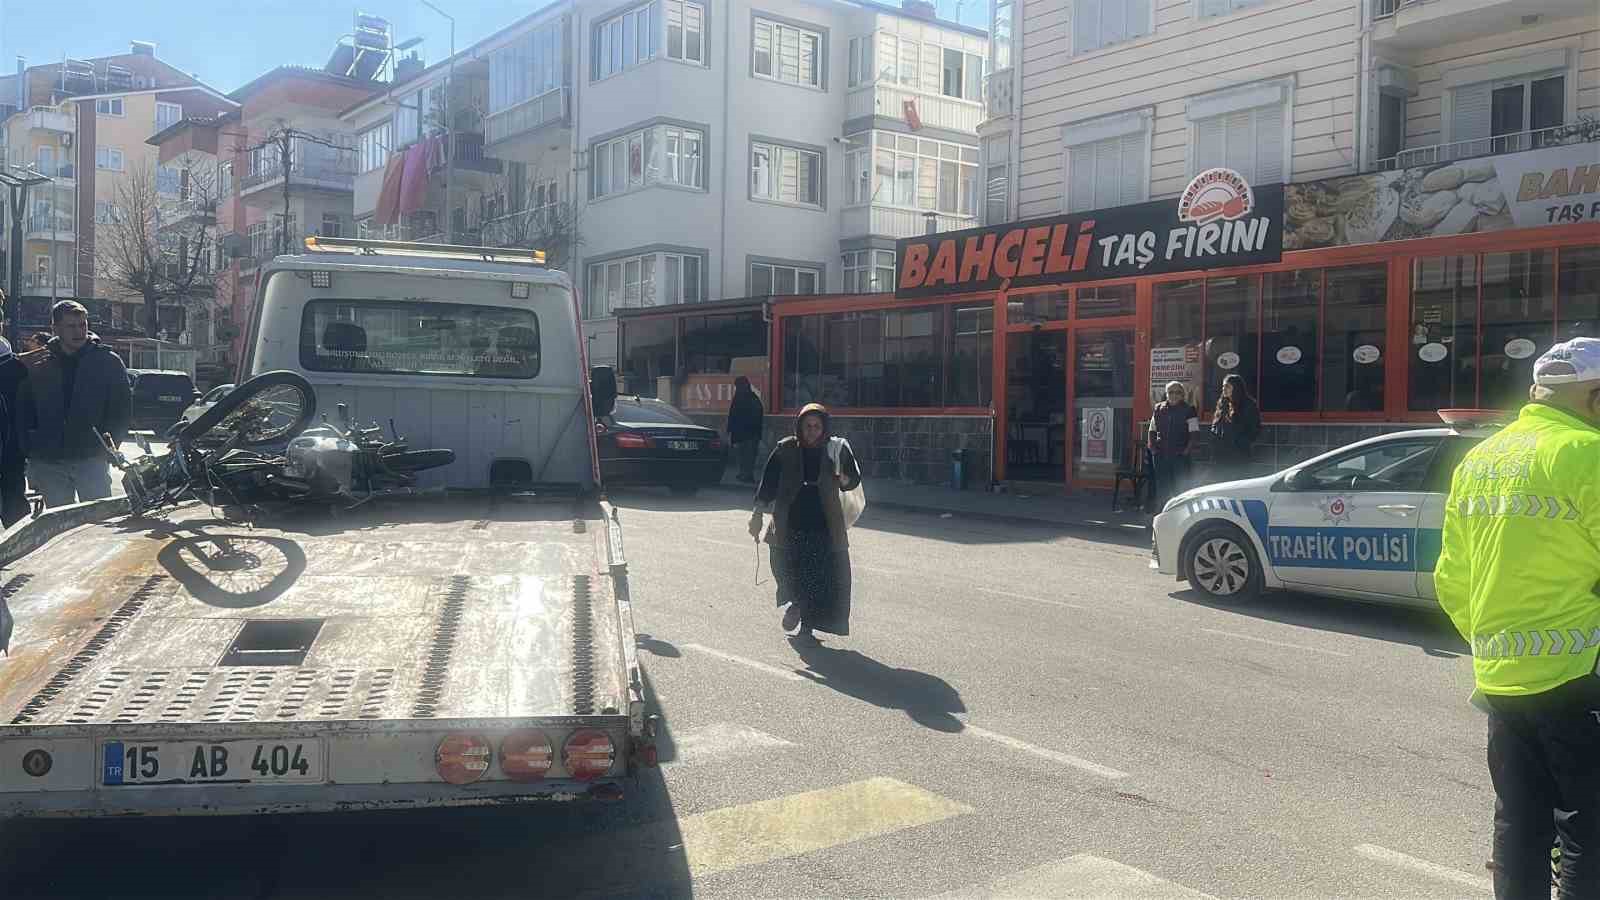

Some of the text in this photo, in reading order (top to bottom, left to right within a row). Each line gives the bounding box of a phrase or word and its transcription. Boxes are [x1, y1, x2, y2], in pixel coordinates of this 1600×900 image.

[1545, 203, 1584, 223] TAŞ
[899, 216, 1270, 293] BAHÇELİ TAŞ FIRINI
[1270, 531, 1408, 562] TRAFİK POLİSİ
[107, 766, 122, 777] TR
[126, 744, 309, 779] 15 AB 404
